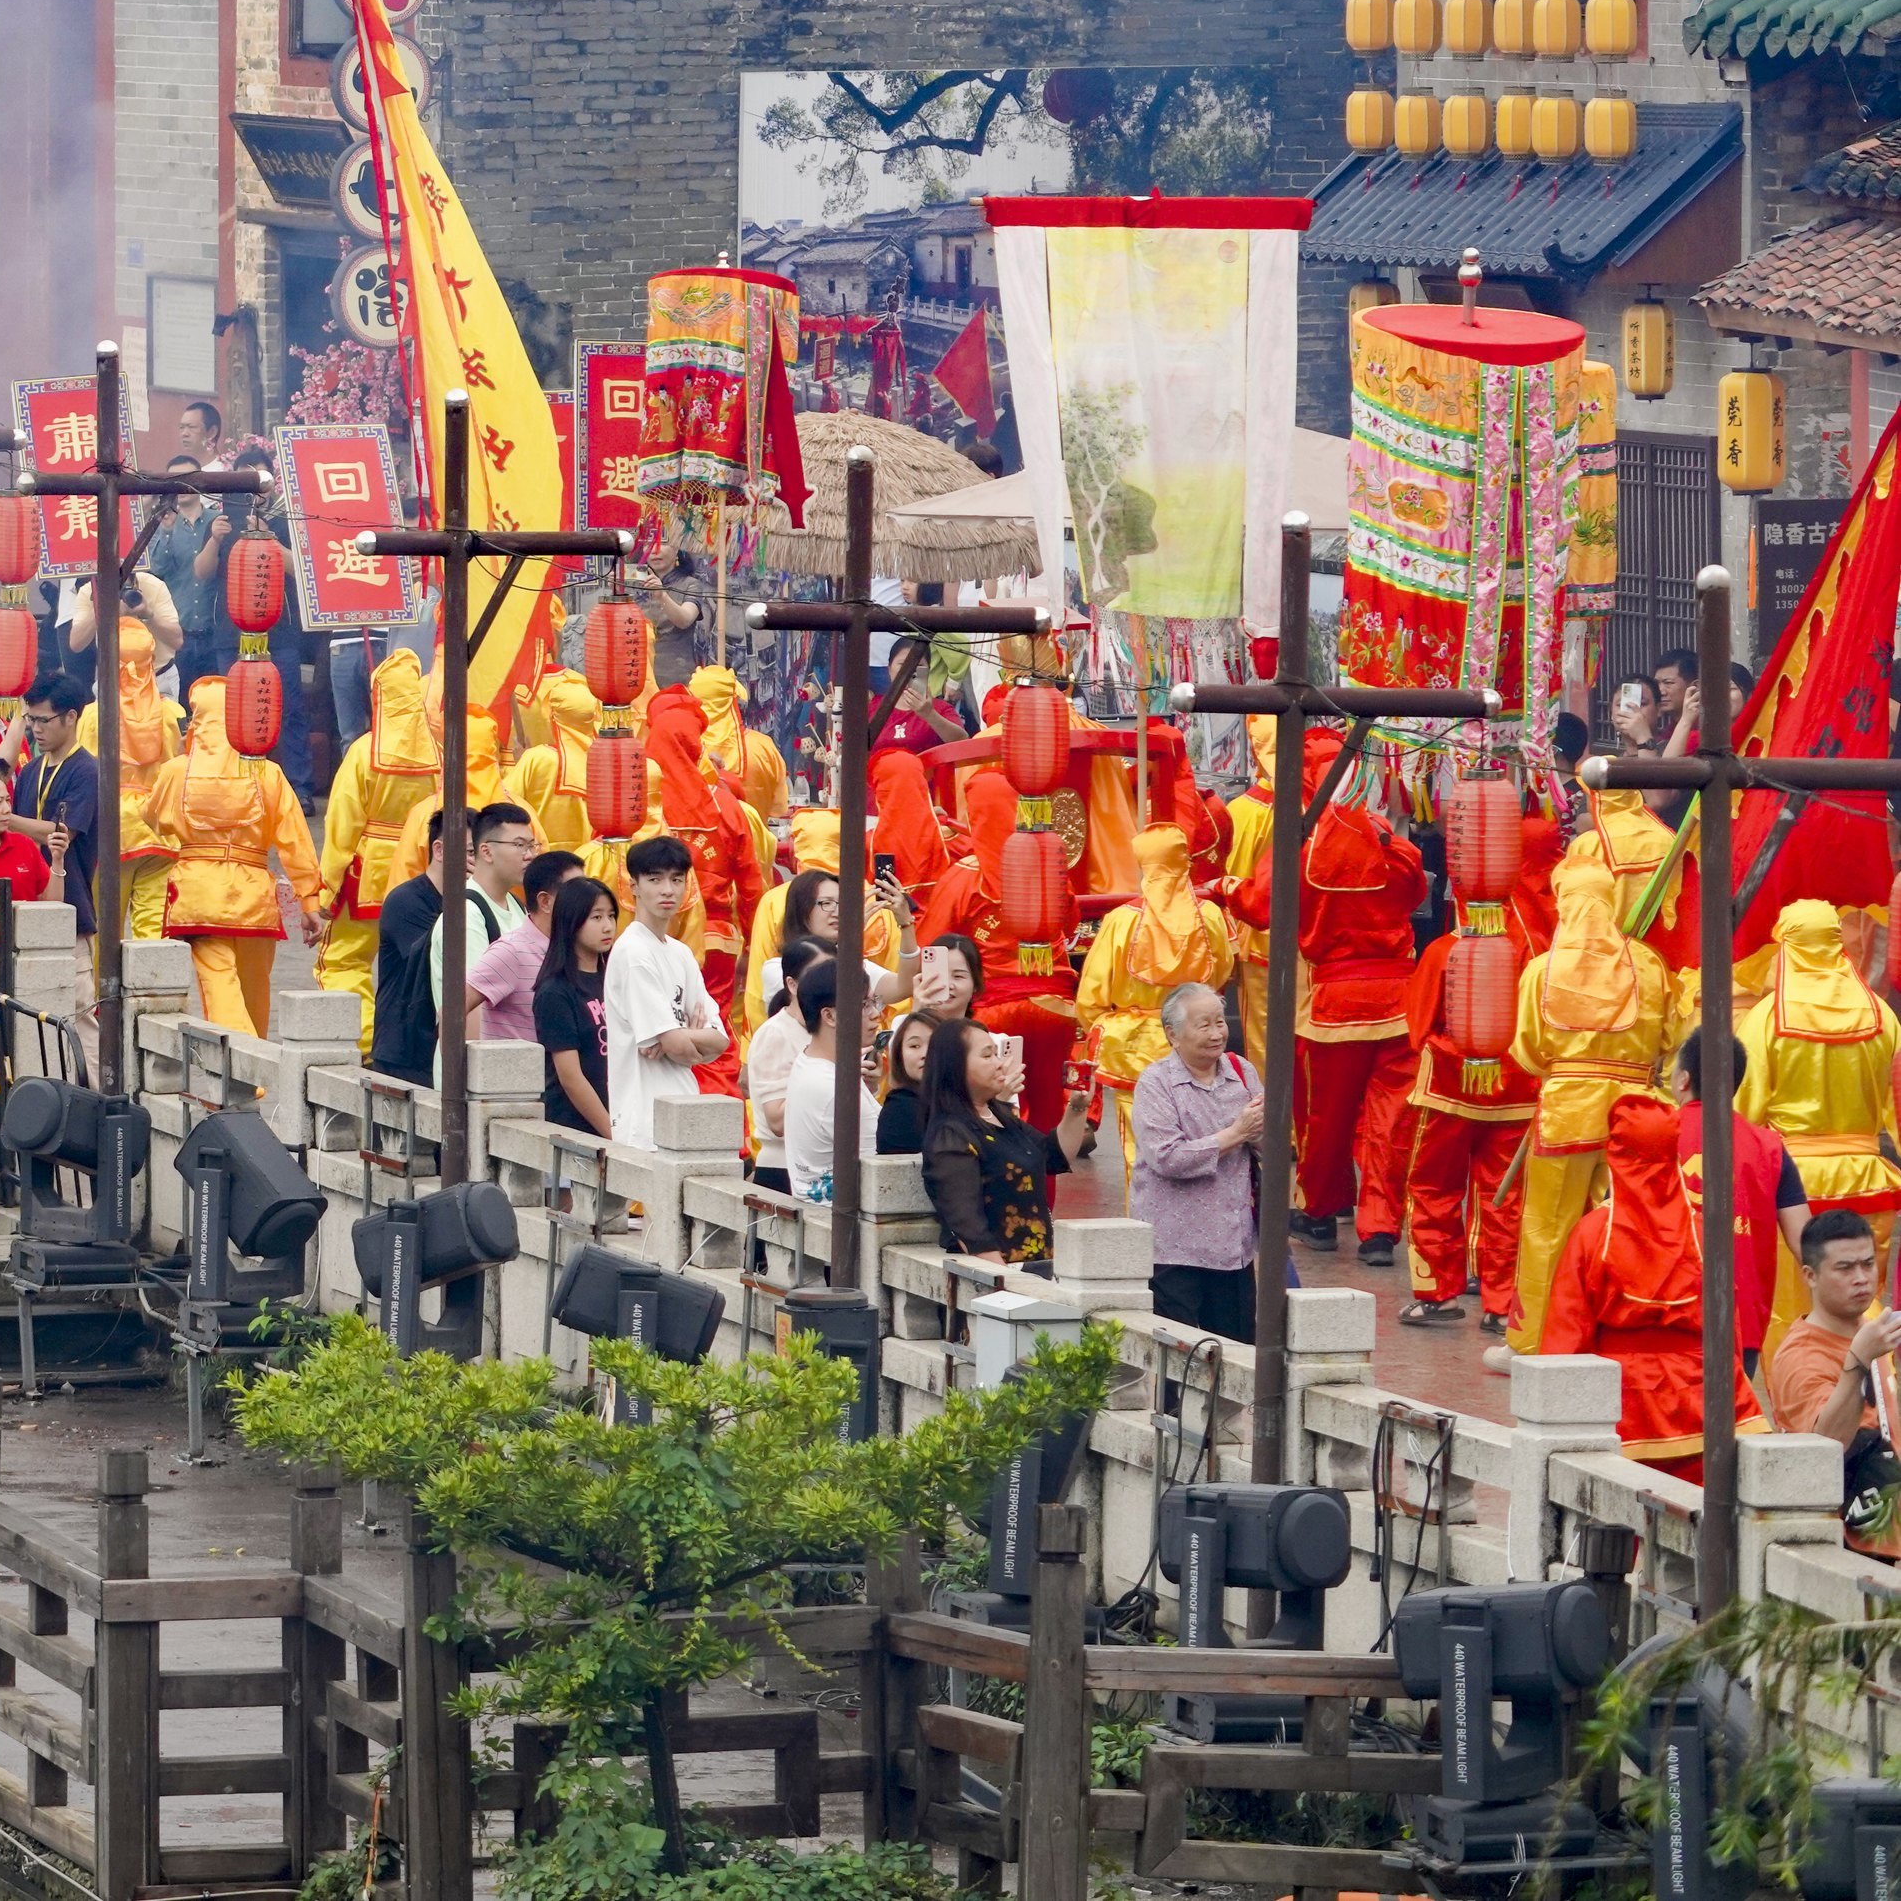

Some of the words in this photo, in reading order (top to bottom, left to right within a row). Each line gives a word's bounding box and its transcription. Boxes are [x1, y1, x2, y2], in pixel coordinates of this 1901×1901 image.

[1629, 321, 1641, 379] 听香茶坊
[1726, 396, 1743, 467] 莞香
[313, 460, 390, 587] 回避
[1775, 585, 1809, 594] 18002
[116, 1142, 124, 1188] WATERPROOF
[116, 1188, 124, 1207] BEAM
[201, 1194, 209, 1244] WATERPROOF
[200, 1244, 208, 1264] BEAM
[394, 1234, 402, 1249] 440
[199, 1264, 207, 1287] LIGHT
[392, 1249, 402, 1301] WATERPROOF
[390, 1301, 400, 1322] BEAM
[632, 1302, 643, 1318] 440
[389, 1322, 399, 1345] LIGHT
[628, 1396, 640, 1419] LIGHT
[1007, 1469, 1021, 1529] WATERPROOF
[1005, 1529, 1017, 1554] BEAM
[1190, 1532, 1199, 1549] 440
[1003, 1554, 1015, 1580] LIGHT
[1189, 1549, 1199, 1613] WATERPROOF
[1189, 1613, 1198, 1639] BEAM
[1454, 1642, 1465, 1660] 440
[1455, 1660, 1466, 1727] WATERPROOF
[1456, 1727, 1467, 1755] BEAM
[1667, 1744, 1679, 1762] 440
[1457, 1756, 1468, 1784] LIGHT
[1670, 1834, 1683, 1865] BEAM
[1874, 1844, 1886, 1863] 440
[1671, 1864, 1685, 1894] LIGHT
